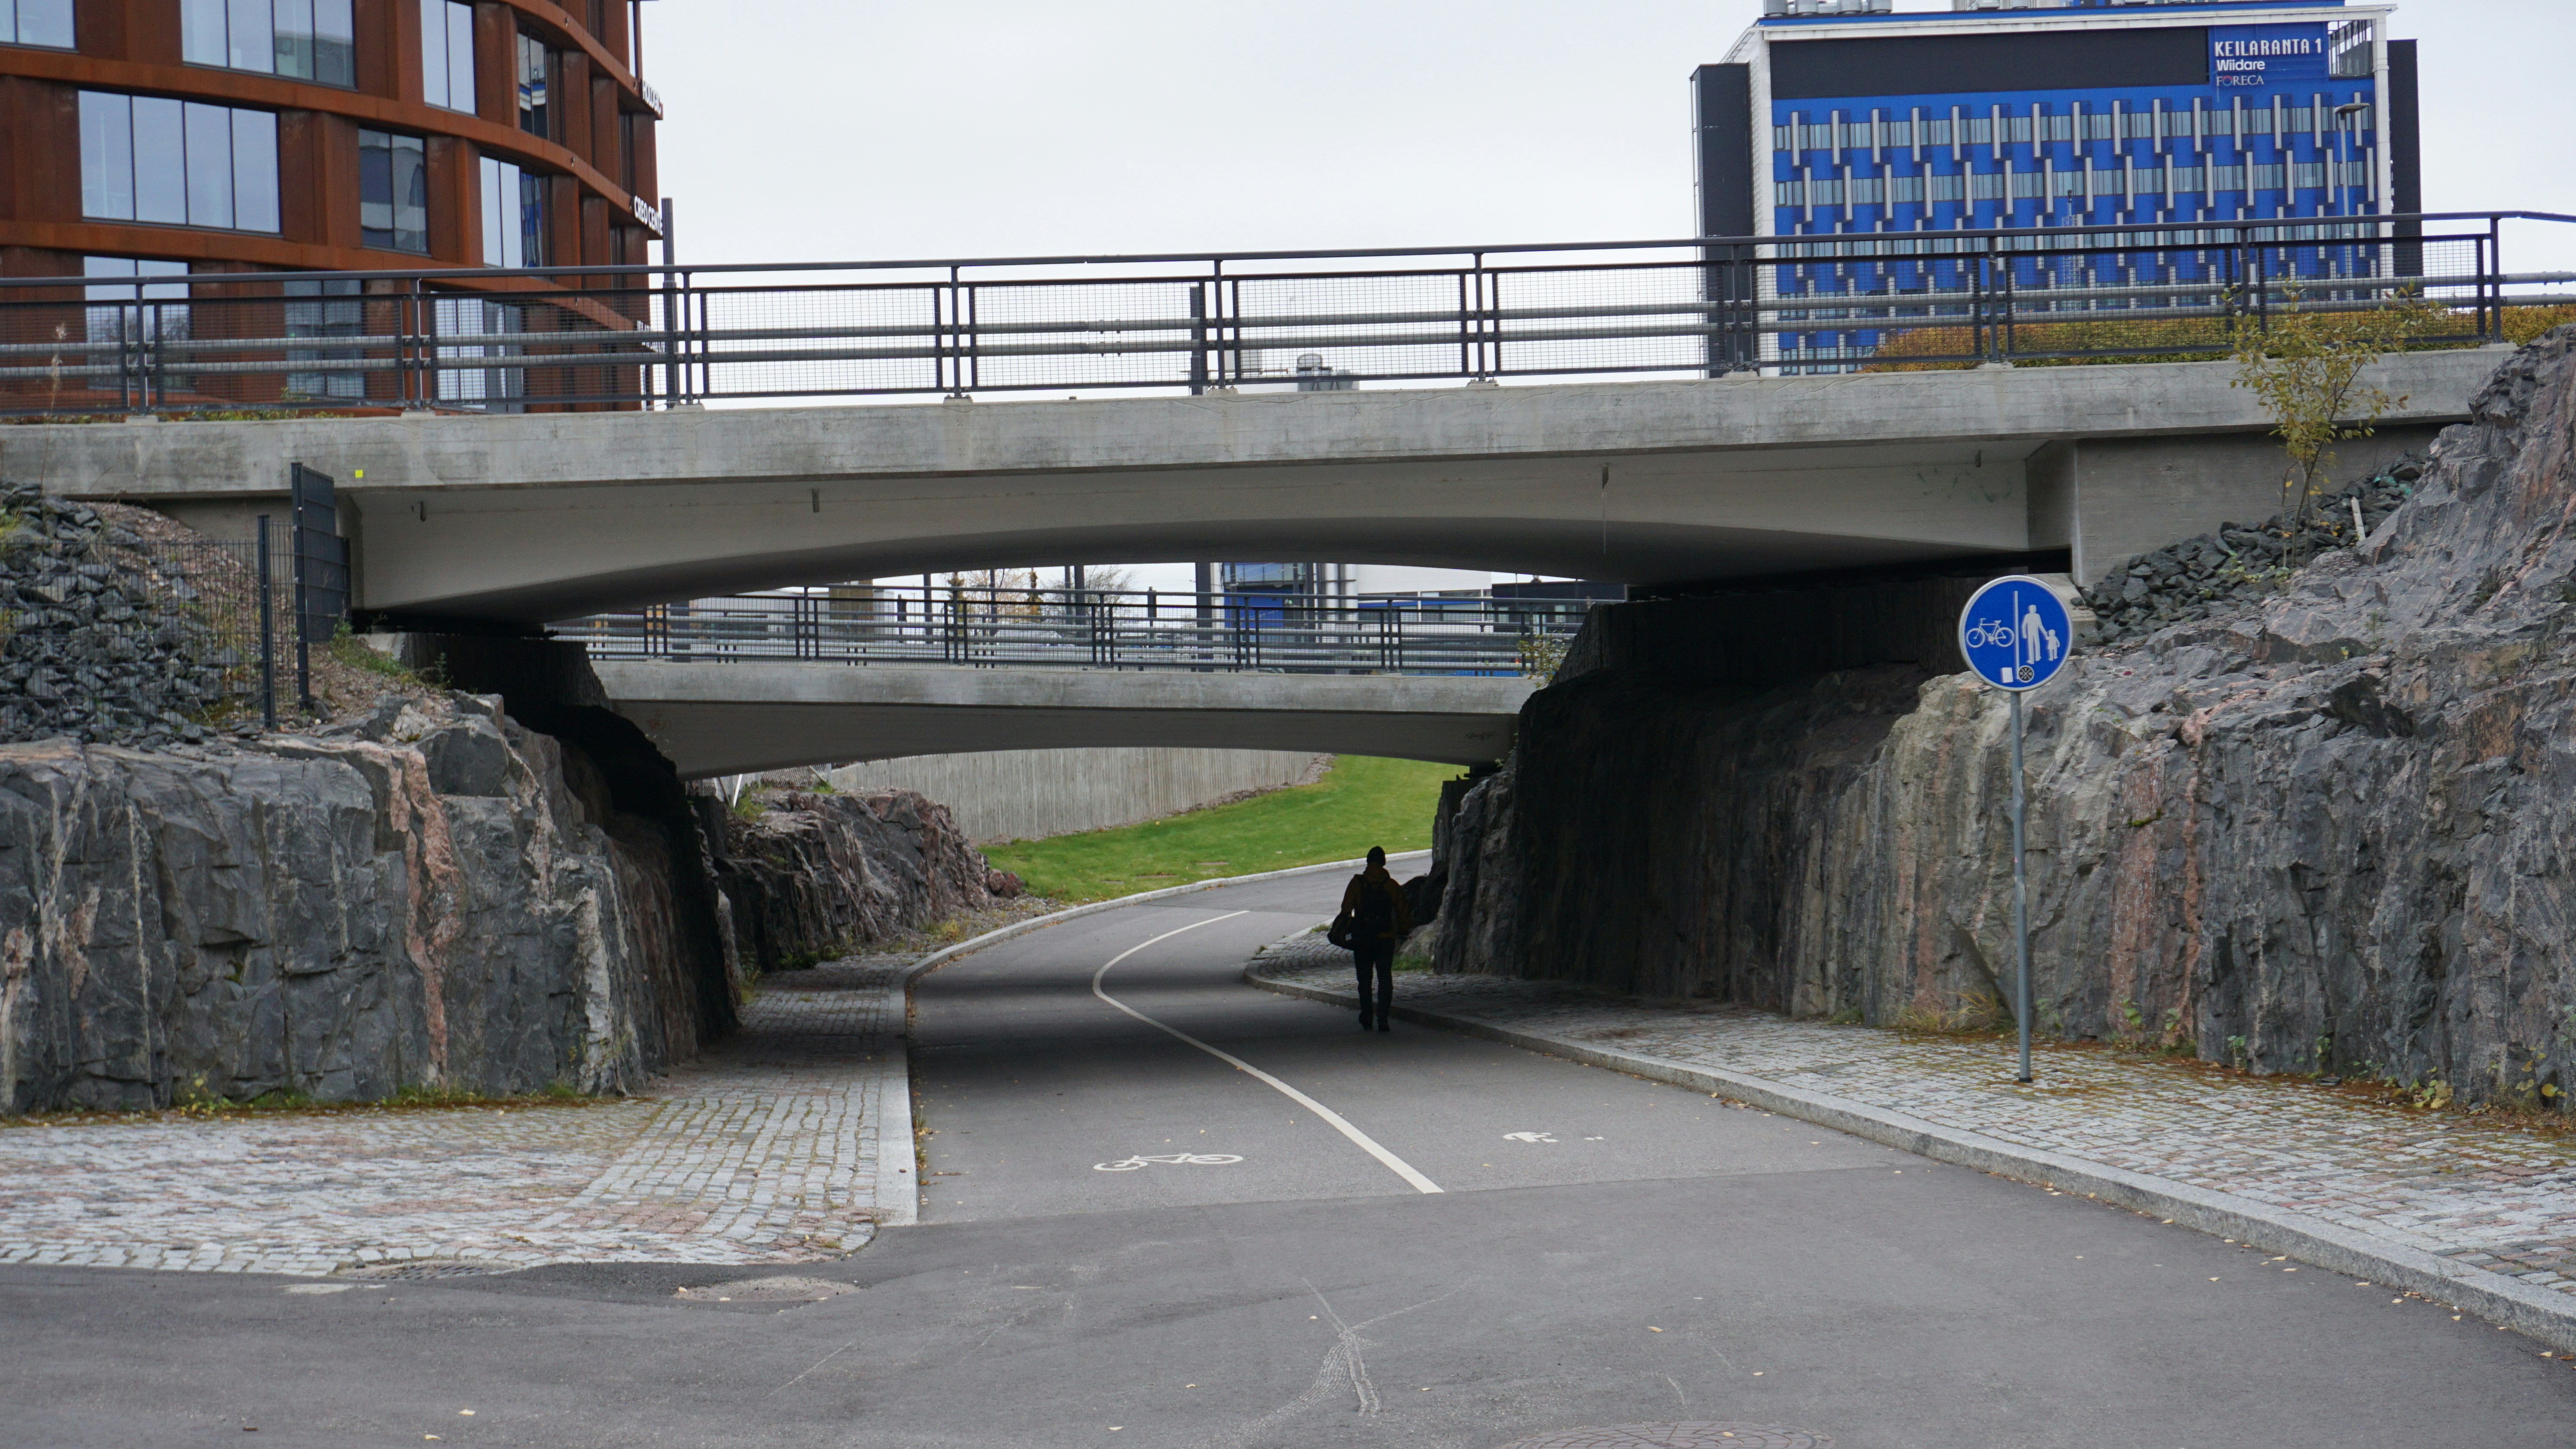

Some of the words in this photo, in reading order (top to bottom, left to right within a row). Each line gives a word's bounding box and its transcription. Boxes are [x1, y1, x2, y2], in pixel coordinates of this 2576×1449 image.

[2215, 39, 2309, 57] KEILARANTA
[2315, 38, 2321, 53] 1
[2216, 59, 2265, 71] Wiidare
[2216, 75, 2264, 86] FORECA
[634, 195, 647, 225] CREO
[648, 206, 663, 236] CENTE
